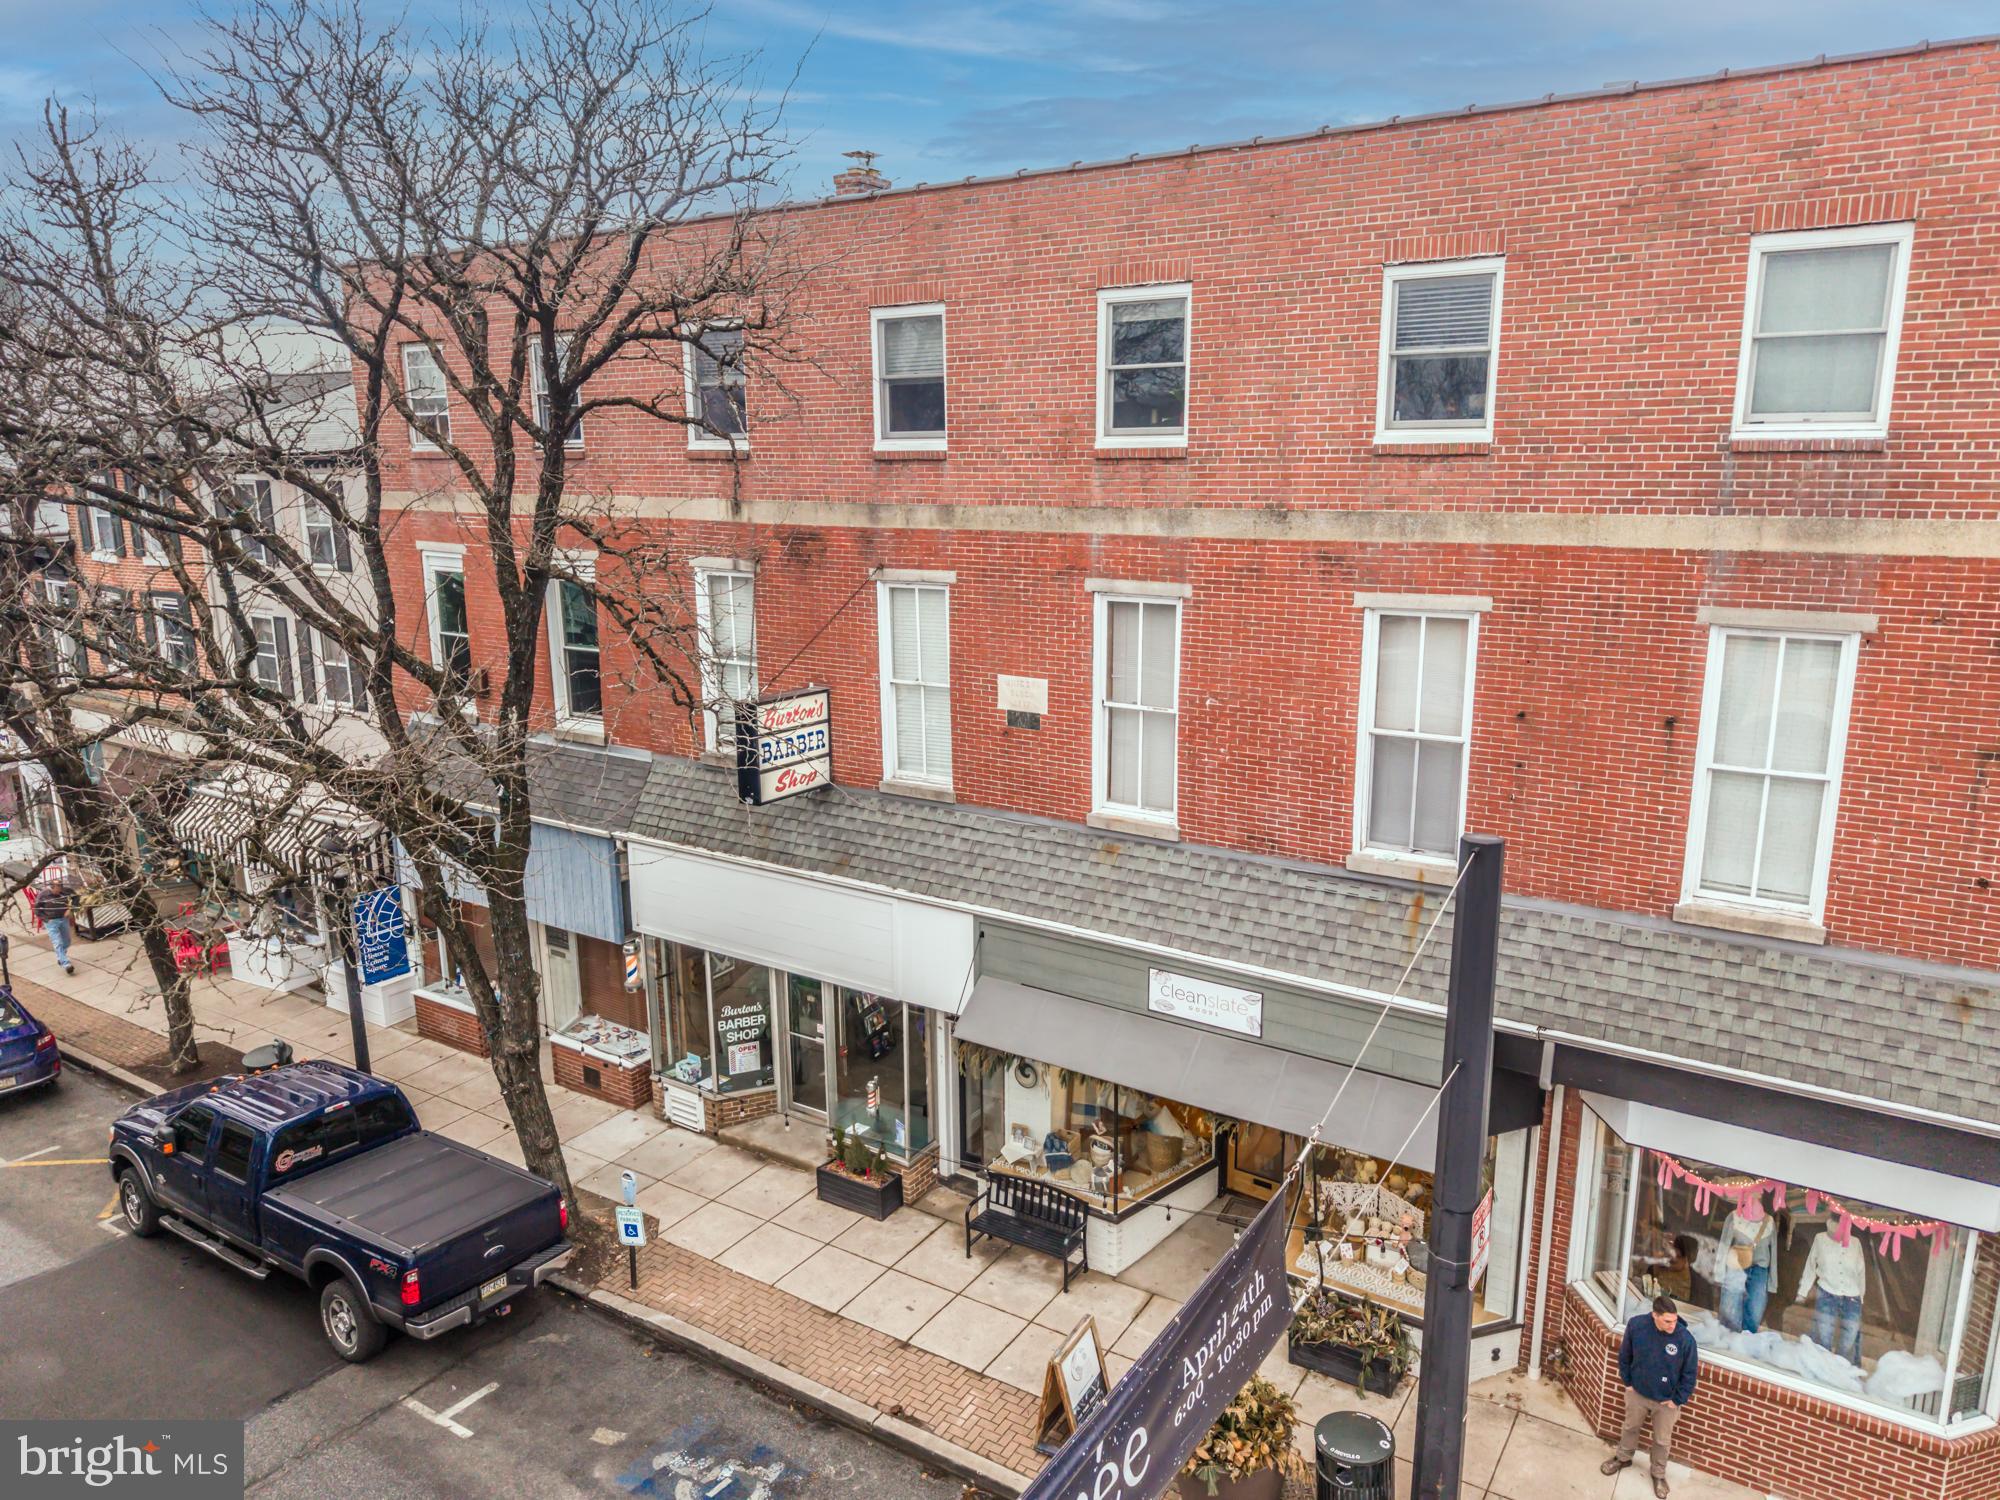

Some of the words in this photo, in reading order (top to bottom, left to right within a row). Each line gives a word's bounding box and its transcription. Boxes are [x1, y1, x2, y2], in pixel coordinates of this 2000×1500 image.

[764, 700, 824, 729] Burton's
[761, 729, 826, 764] BARBER
[775, 768, 818, 793] Shop
[720, 1002, 763, 1018] Burton's
[1160, 983, 1248, 1016] cleanslate
[717, 1014, 767, 1031] BARBER
[726, 1028, 760, 1043] SHOP
[738, 1044, 757, 1053] OPEN
[1182, 1311, 1228, 1390] April
[1230, 1269, 1266, 1328] 24th
[1174, 1379, 1204, 1427] 6:00
[1217, 1320, 1250, 1374] 10:30
[1252, 1294, 1273, 1334] pm
